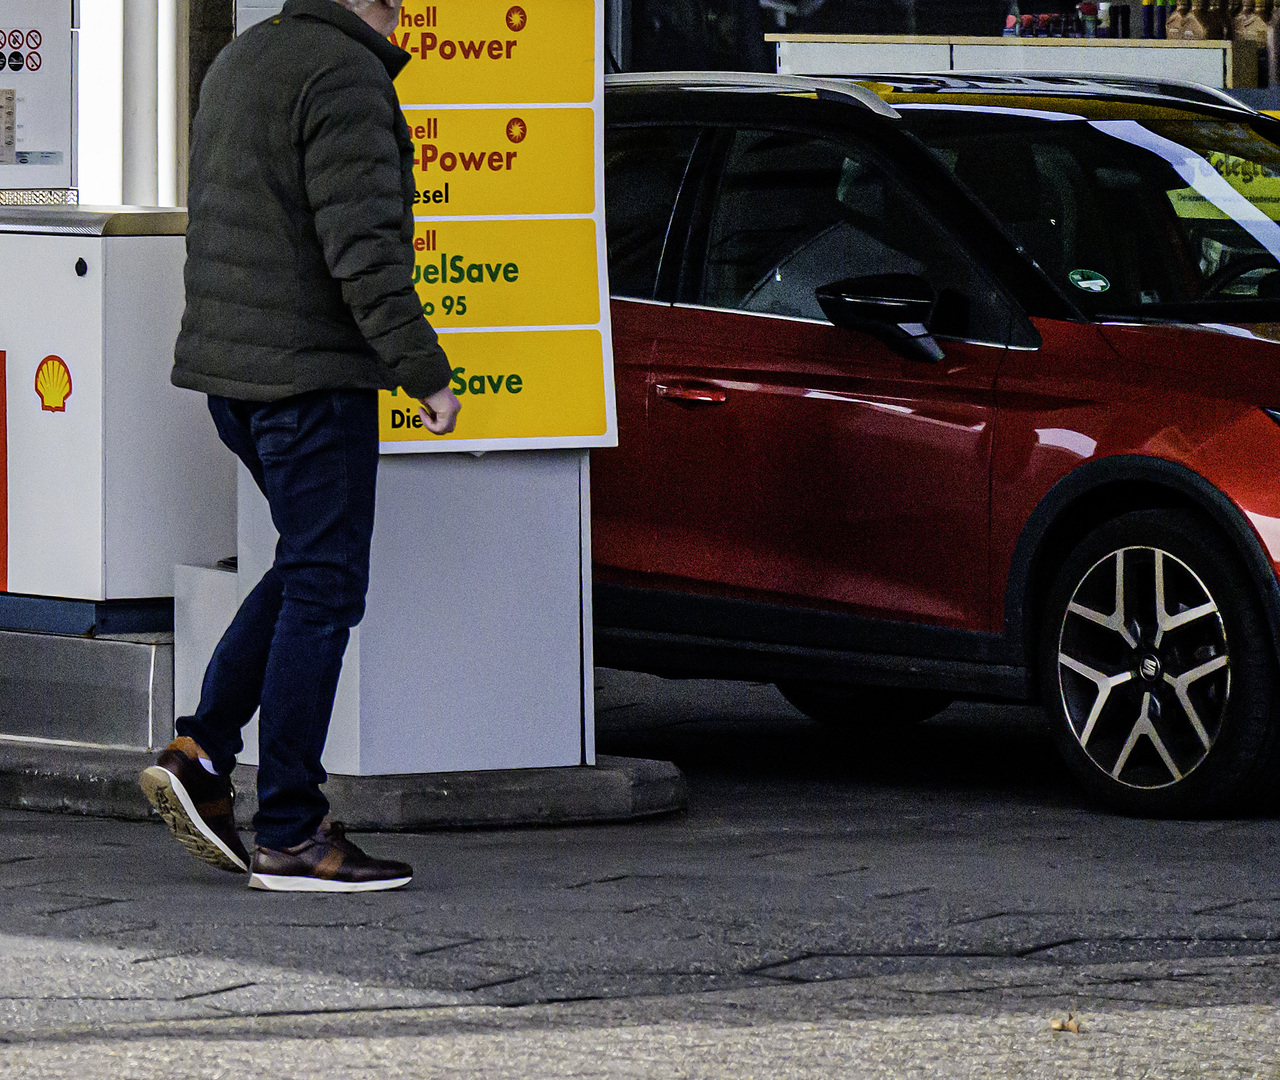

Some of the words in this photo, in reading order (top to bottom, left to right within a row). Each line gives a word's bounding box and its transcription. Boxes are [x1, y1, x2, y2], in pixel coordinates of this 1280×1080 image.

[398, 6, 437, 28] hell
[408, 118, 438, 139] ell
[413, 144, 518, 172] -Power
[413, 182, 449, 205] esel
[413, 229, 437, 251] ell
[411, 253, 520, 284] uelSave
[441, 295, 467, 316] 95
[391, 408, 423, 429] Die
